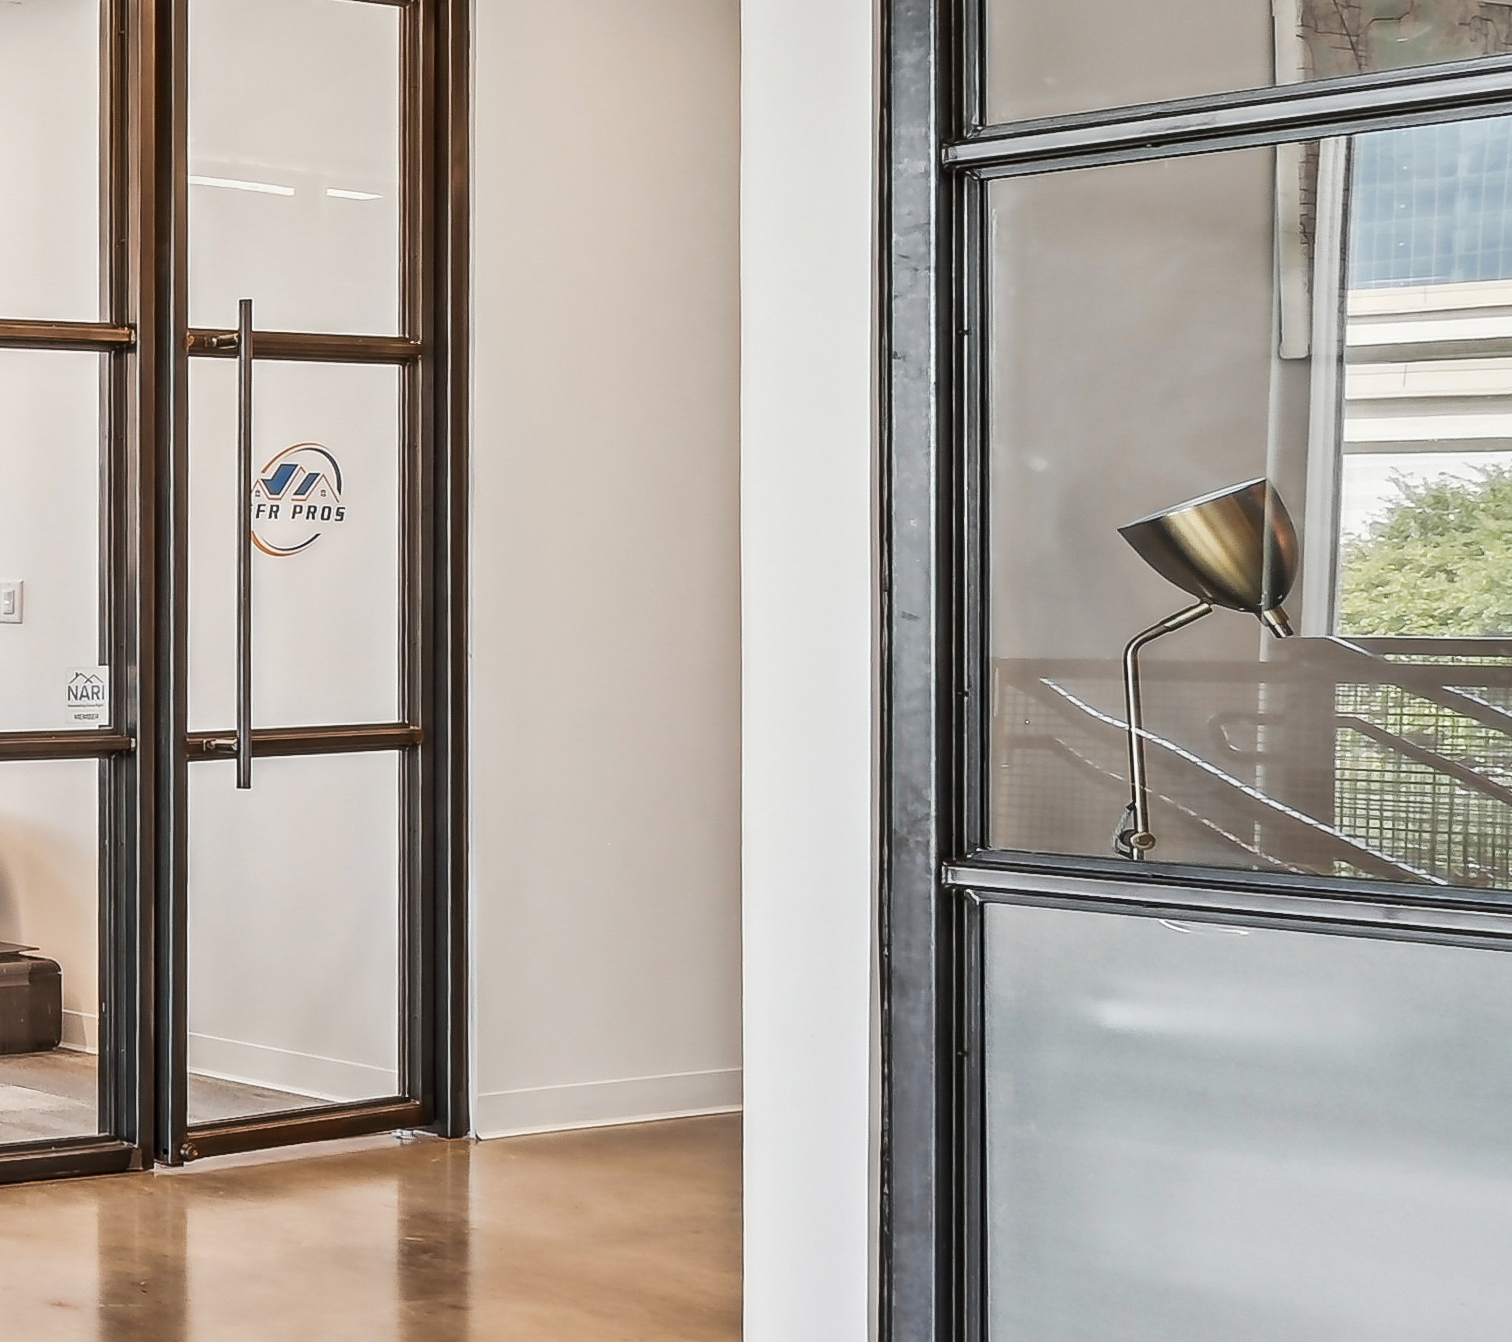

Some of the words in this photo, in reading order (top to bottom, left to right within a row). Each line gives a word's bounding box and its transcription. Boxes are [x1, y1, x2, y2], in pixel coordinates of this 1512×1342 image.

[251, 503, 280, 520] FR
[291, 504, 346, 522] PROS
[67, 685, 104, 701] NARI
